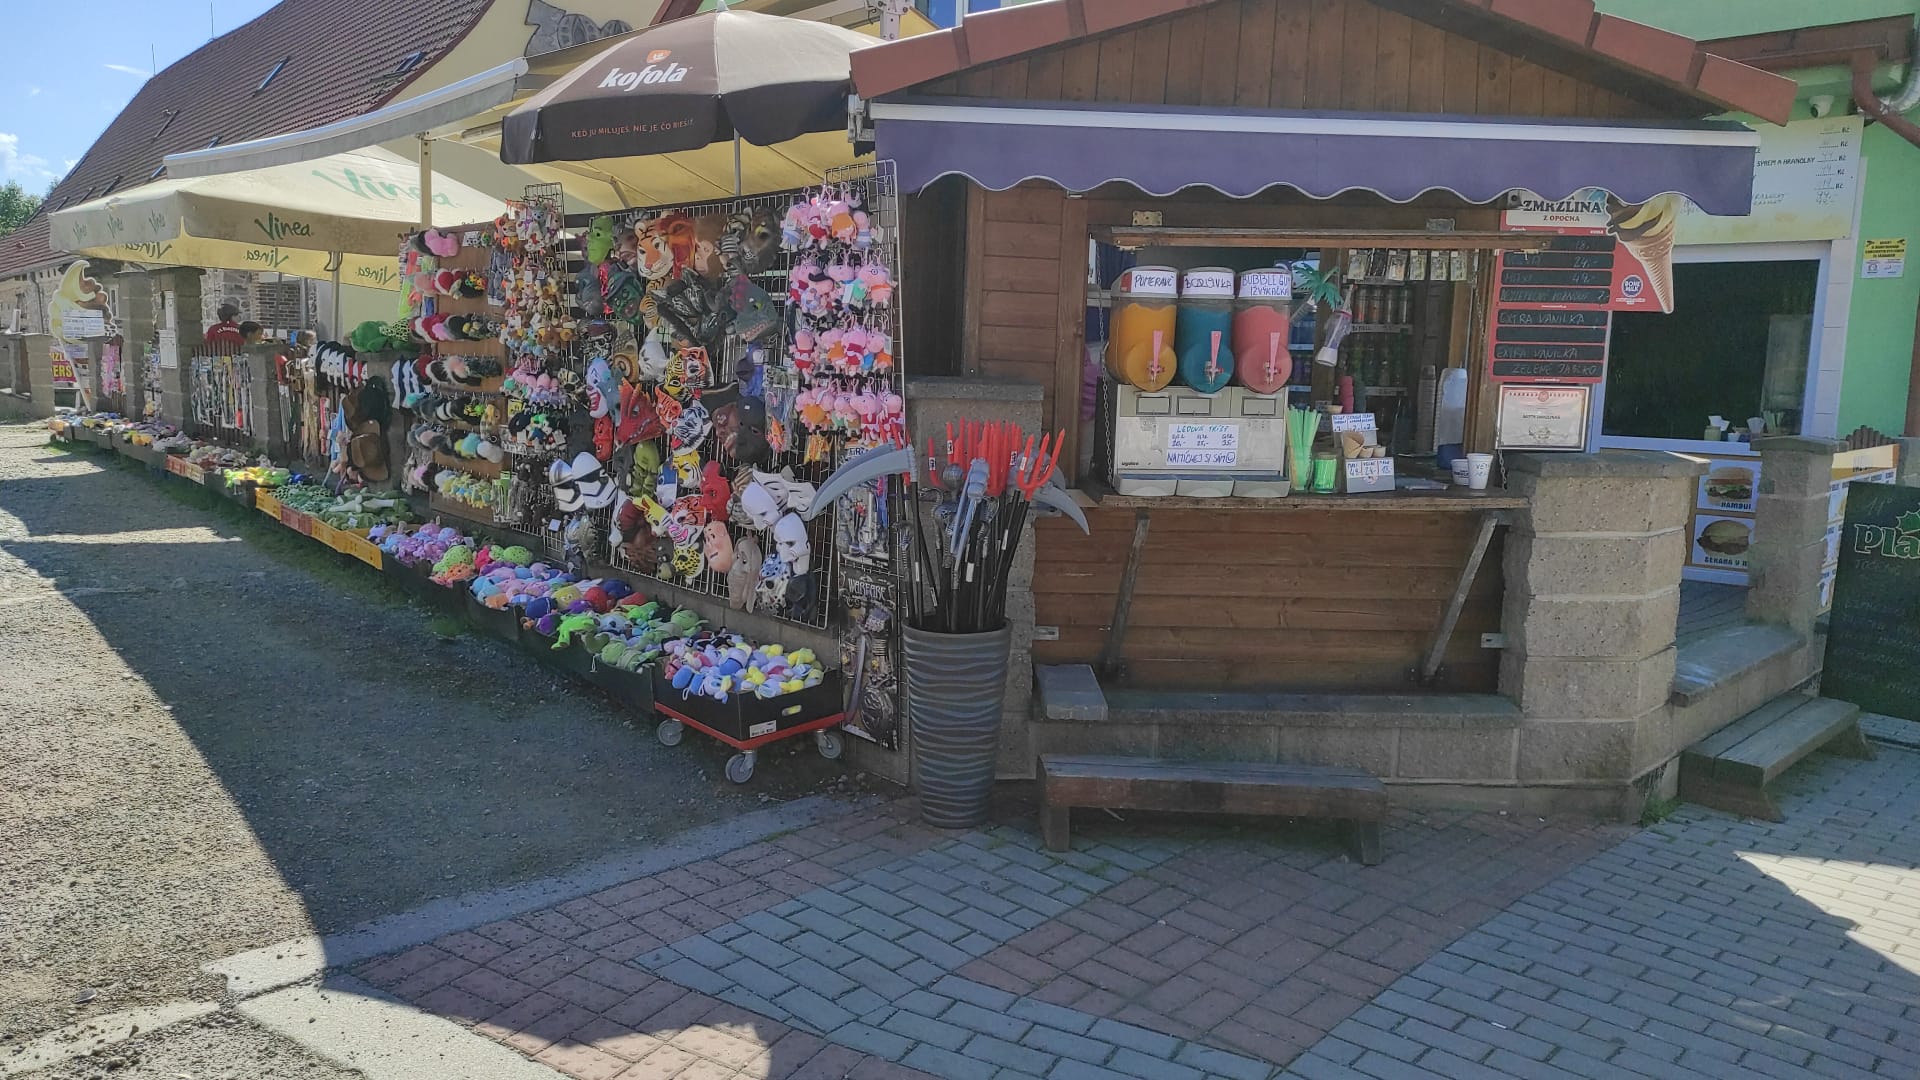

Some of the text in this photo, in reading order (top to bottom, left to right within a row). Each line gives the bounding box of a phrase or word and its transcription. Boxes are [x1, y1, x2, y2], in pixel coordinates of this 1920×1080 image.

[597, 62, 688, 92] kofola
[633, 123, 647, 133] NIE
[649, 123, 658, 133] JE
[1523, 200, 1602, 213] ZMRZLINA
[254, 212, 312, 241] Vinea
